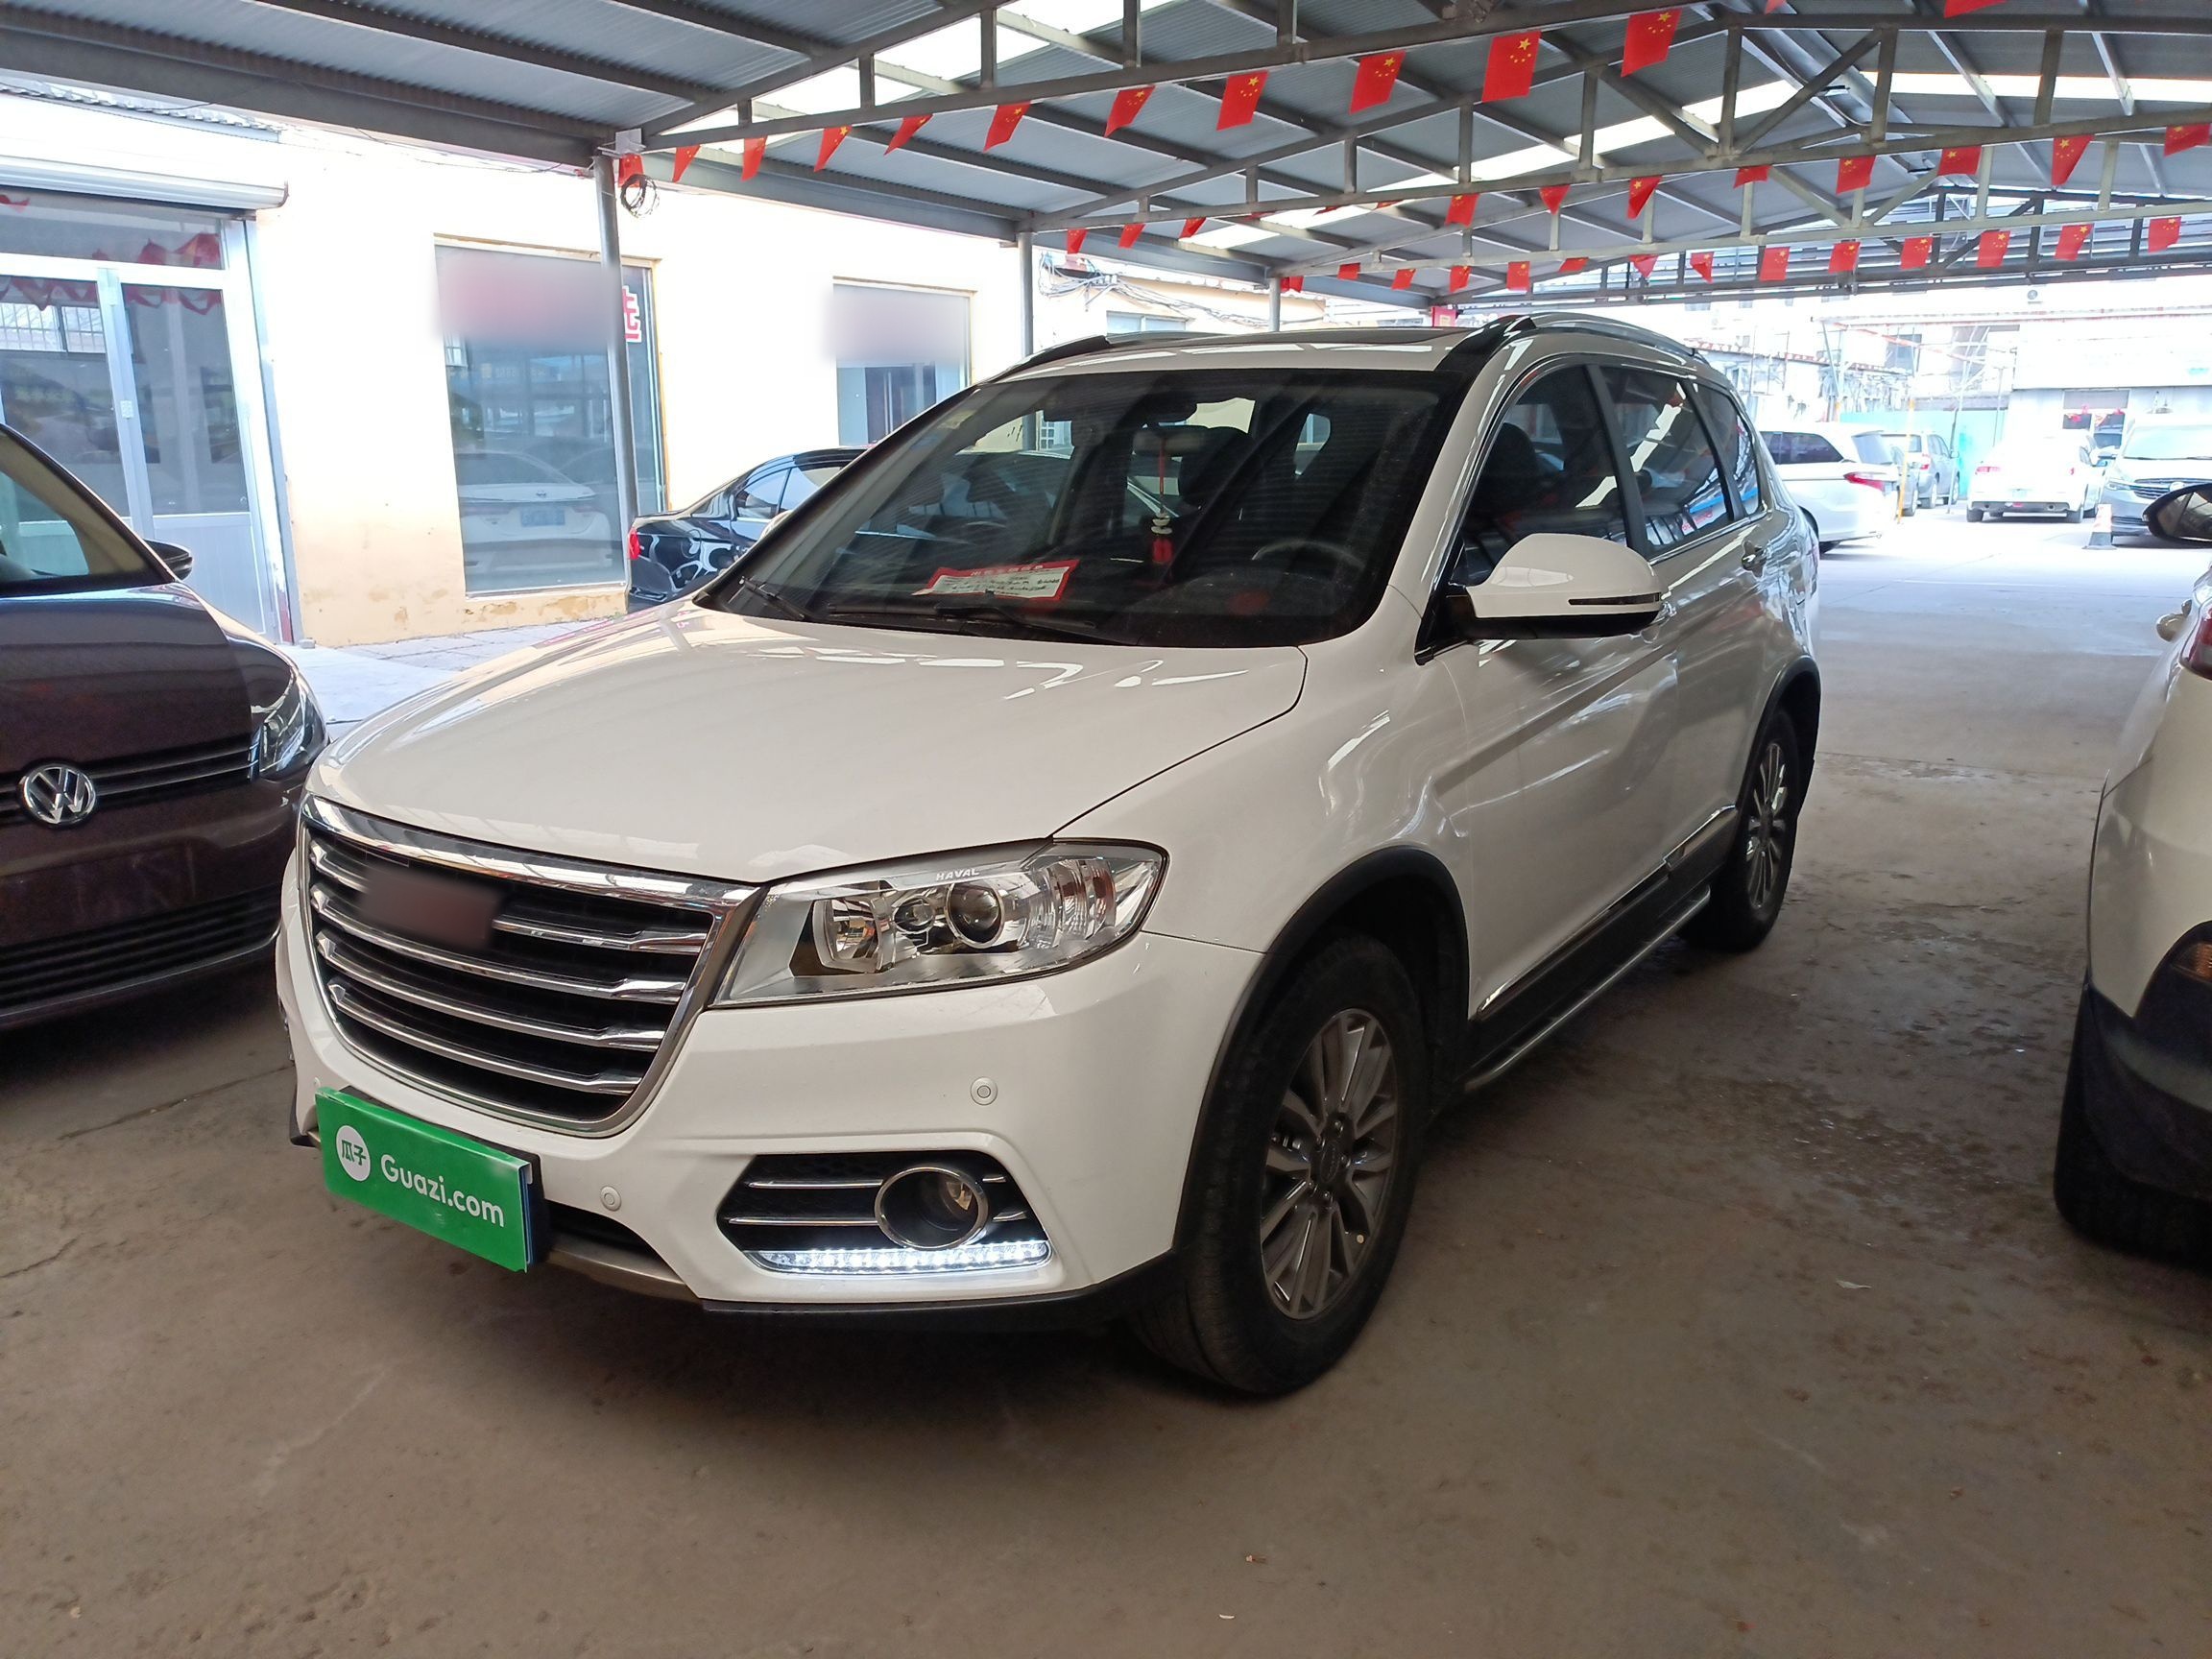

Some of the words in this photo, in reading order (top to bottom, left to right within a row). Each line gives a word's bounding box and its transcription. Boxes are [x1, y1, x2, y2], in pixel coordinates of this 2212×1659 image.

[936, 867, 980, 880] HAVAL
[341, 1140, 367, 1166] 瓜子
[380, 1154, 505, 1228] Guazi.com
